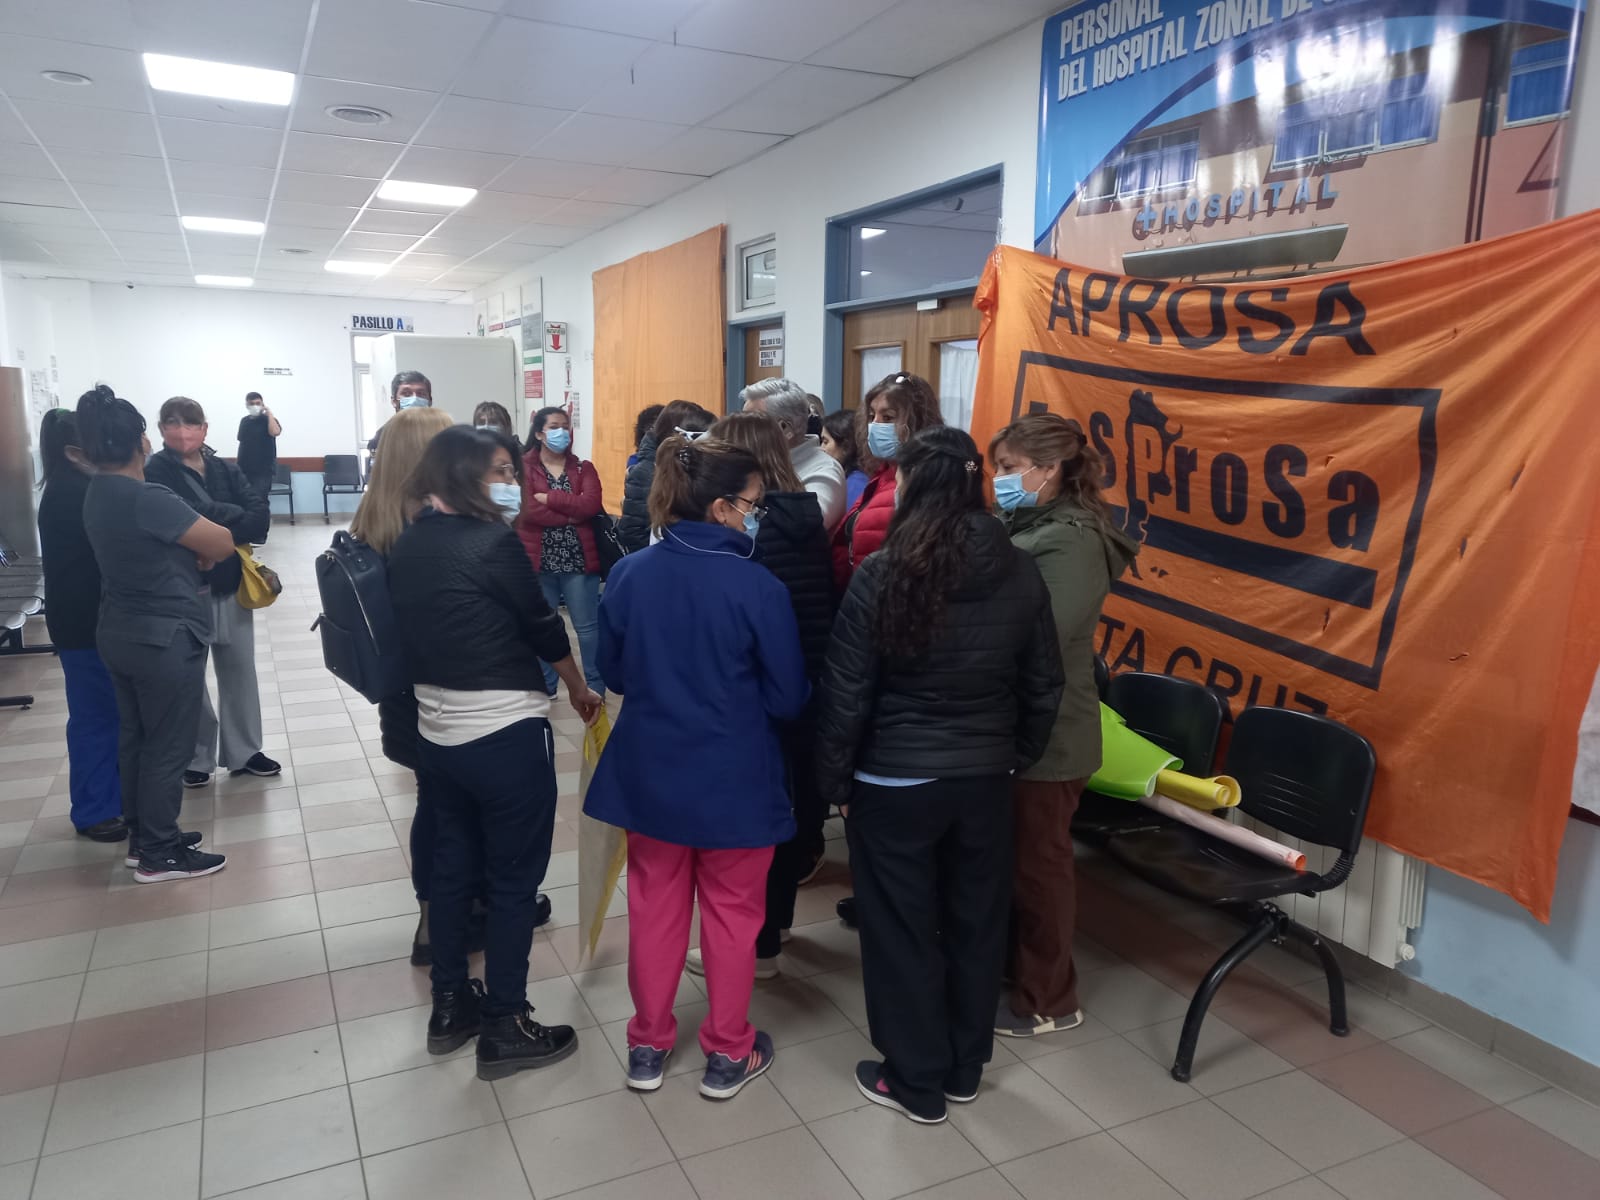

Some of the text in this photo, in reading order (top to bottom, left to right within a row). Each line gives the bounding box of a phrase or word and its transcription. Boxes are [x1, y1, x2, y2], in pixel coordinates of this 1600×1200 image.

[1058, 56, 1087, 103] DEL
[1092, 16, 1187, 89] HOSPITAL
[1194, 0, 1273, 51] ZONAL
[1060, 0, 1164, 60] PERSONAL
[1165, 173, 1340, 226] HOSPITAL
[352, 315, 394, 330] PASILLO
[396, 317, 404, 330] A
[1046, 267, 1376, 356] APROSA
